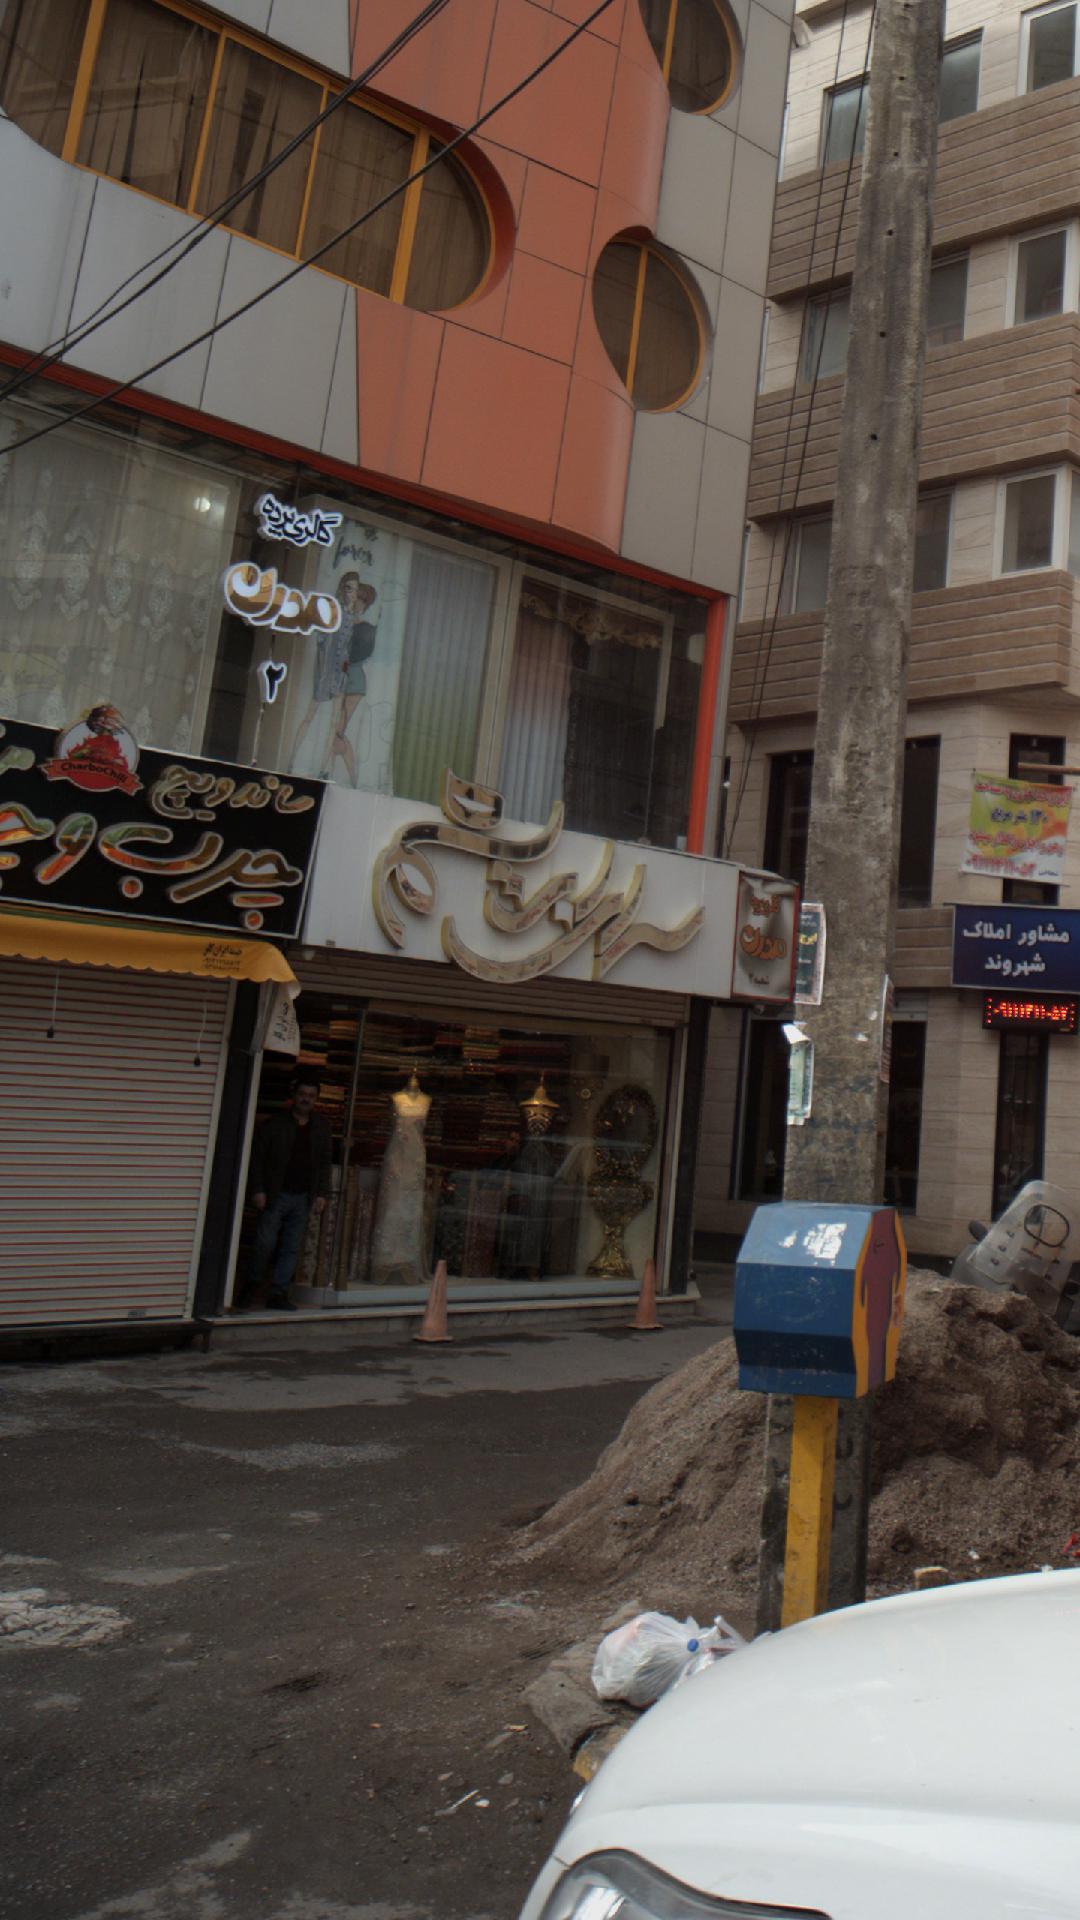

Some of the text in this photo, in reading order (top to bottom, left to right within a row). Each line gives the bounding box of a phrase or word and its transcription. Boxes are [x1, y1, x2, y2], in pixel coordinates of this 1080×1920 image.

[261, 495, 341, 546] گالری پرده
[225, 562, 342, 634] مدرن
[264, 663, 287, 703] ۲
[152, 765, 315, 821] ساندویچ
[36, 813, 97, 885] و
[99, 822, 303, 931] چرب
[741, 924, 787, 960] مدرن
[962, 920, 1070, 946] مشاور املاک
[984, 952, 1045, 977] شهروند
